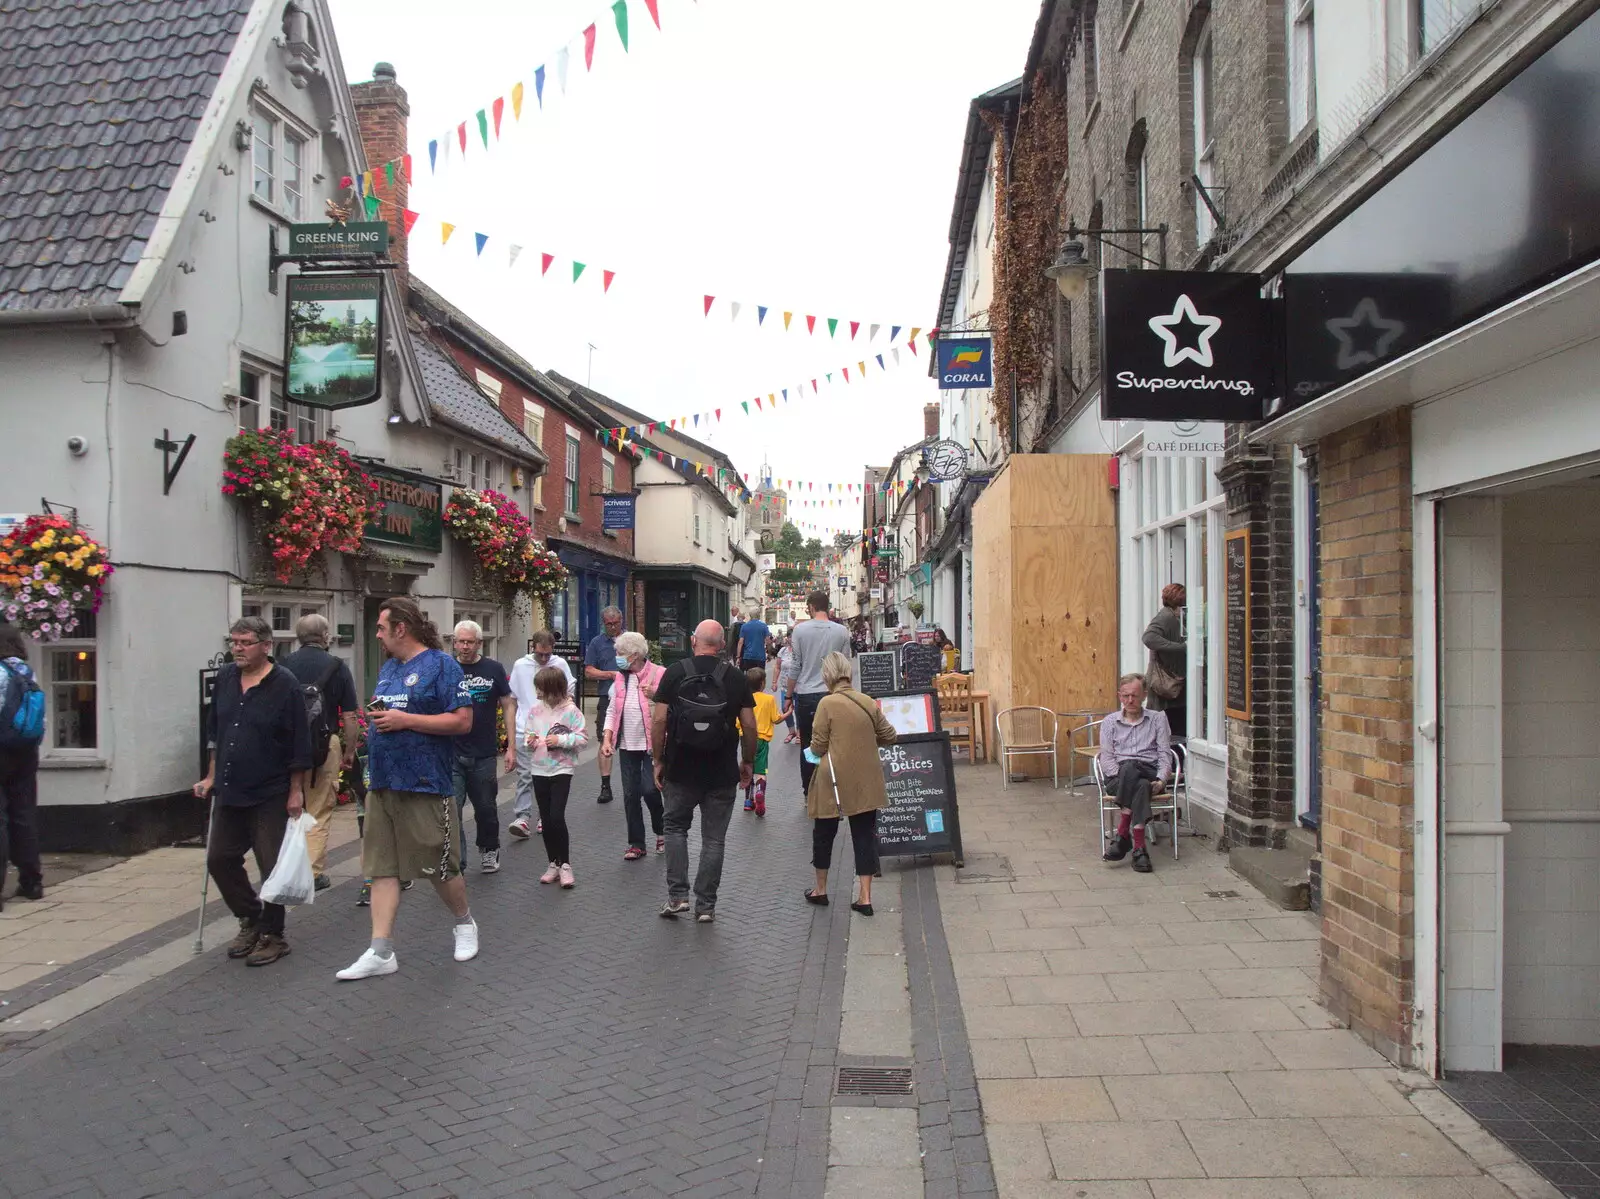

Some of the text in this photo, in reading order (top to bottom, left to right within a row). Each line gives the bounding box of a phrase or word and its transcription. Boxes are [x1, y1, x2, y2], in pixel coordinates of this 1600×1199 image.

[295, 231, 379, 243] GREENE KING
[295, 281, 376, 292] WATERFRONT INN
[944, 373, 986, 383] CORAL
[1116, 371, 1254, 396] Superdrug
[1147, 440, 1226, 452] CAFÉ DELICES
[376, 477, 440, 512] TERFRONT
[386, 512, 412, 536] INN
[878, 745, 907, 762] Café
[907, 778, 923, 788] Bite
